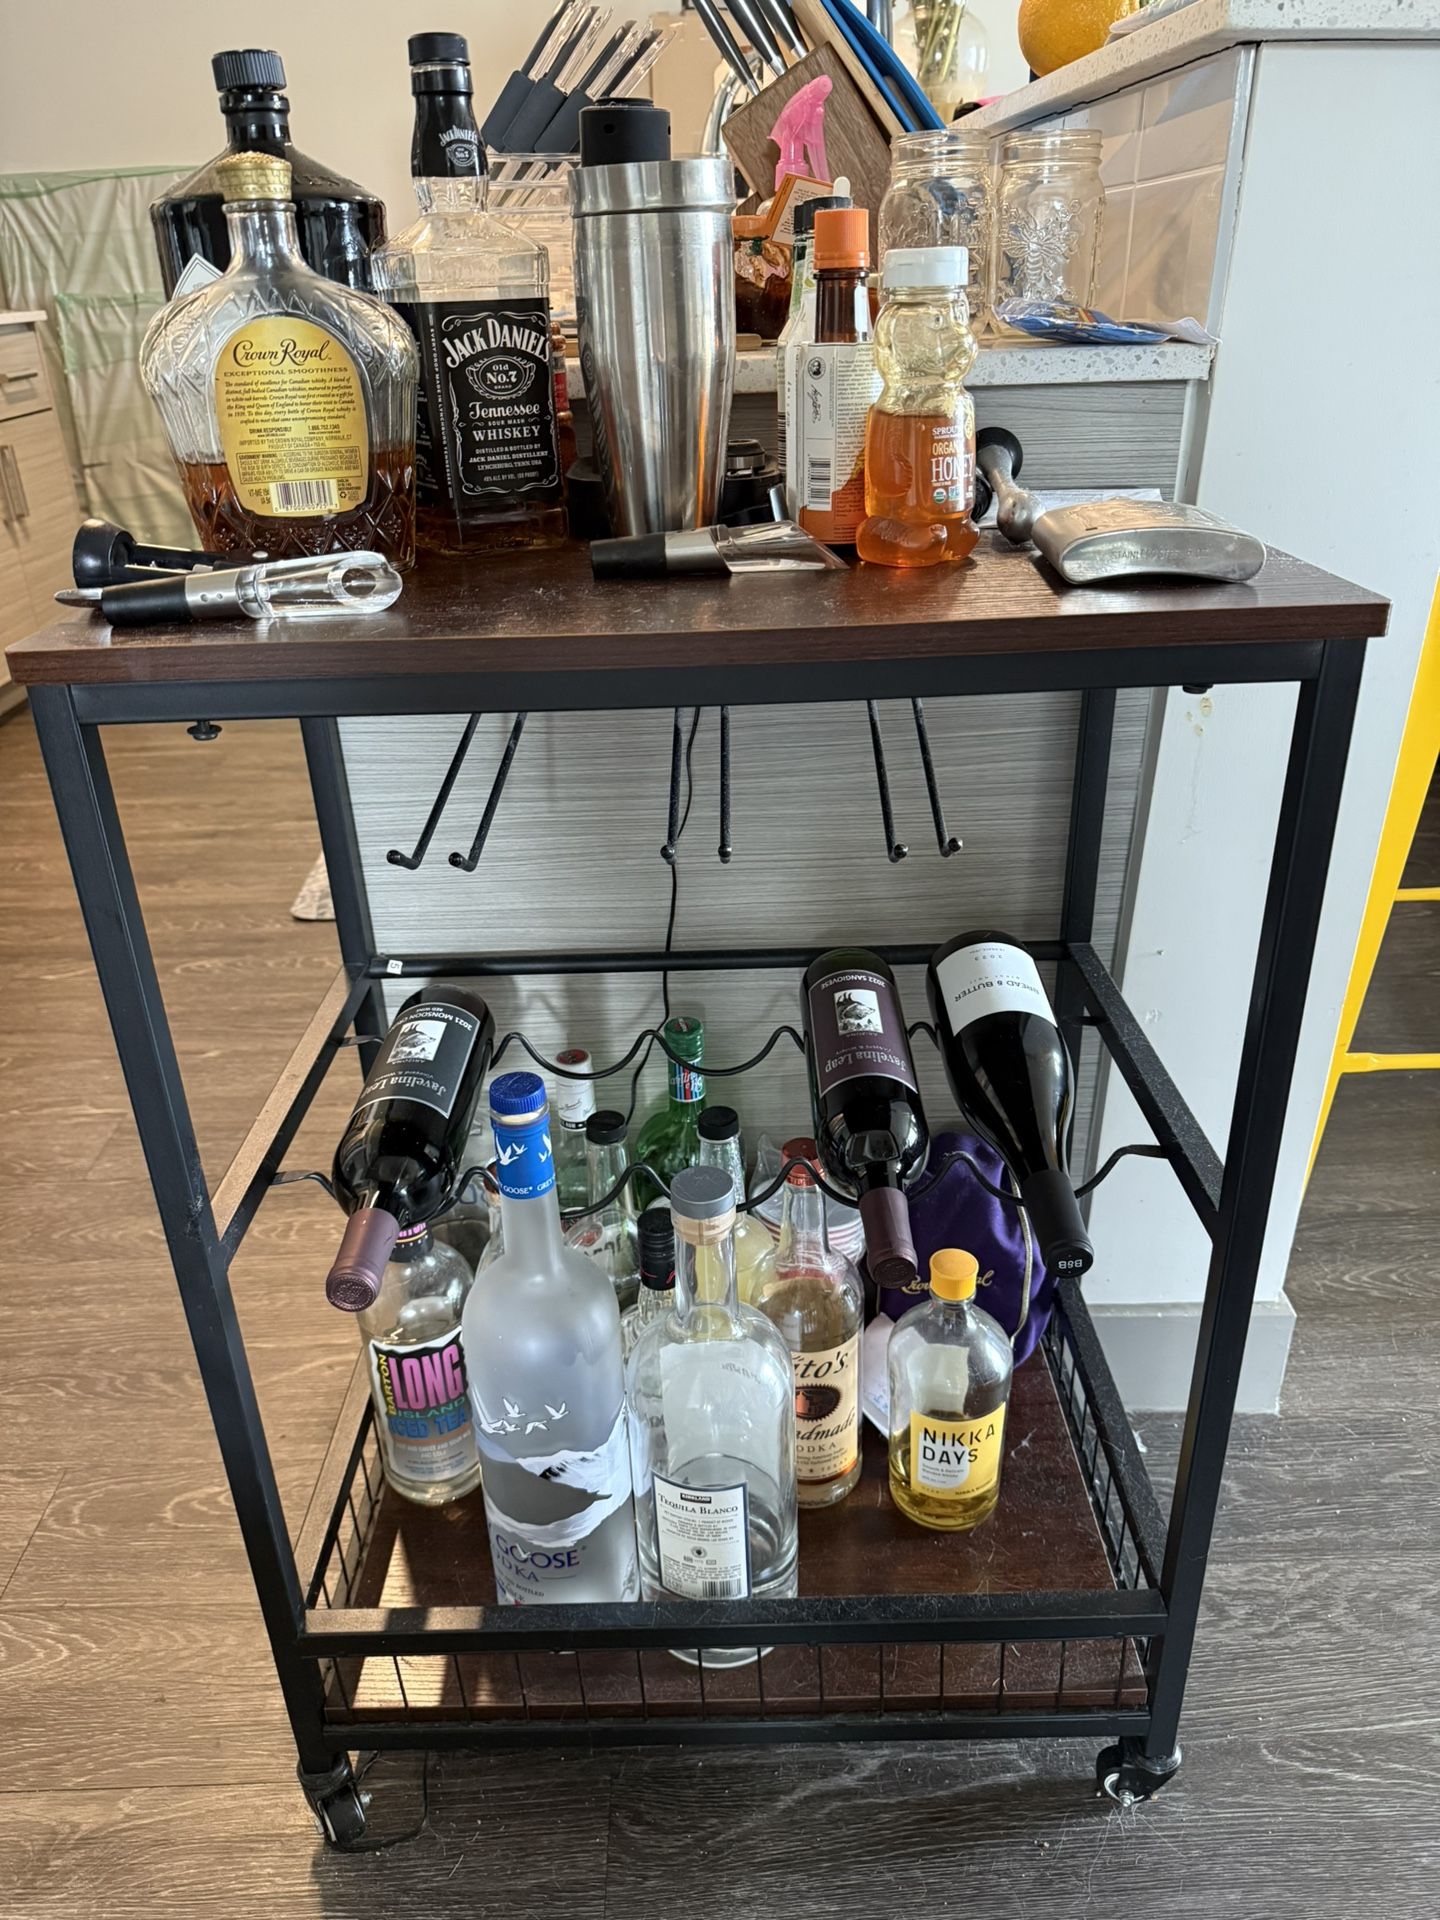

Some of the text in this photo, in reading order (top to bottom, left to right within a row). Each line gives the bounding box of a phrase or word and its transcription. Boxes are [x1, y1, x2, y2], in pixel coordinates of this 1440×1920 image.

[232, 338, 330, 367] Crown Royal
[442, 318, 550, 368] JACK DANIEL'S
[224, 369, 285, 377] EXCEPTIONAL
[486, 371, 517, 384] No.7
[469, 402, 540, 419] Tennessee
[472, 425, 540, 441] WHISKEY
[476, 446, 504, 454] DISTILLED
[487, 454, 511, 462] DANIEL
[512, 451, 548, 459] DISTILLERY
[821, 974, 886, 990] 2022 SANGIOVESE
[955, 981, 994, 1002] BUTTER
[408, 1012, 454, 1020] MONSOON
[454, 1016, 473, 1031] 2021
[825, 1050, 907, 1073] Javelina Leap
[362, 1075, 446, 1098] Javelina Lea
[503, 1186, 529, 1194] GOOSE
[793, 1351, 848, 1378] ito's
[379, 1353, 397, 1416] BARTON
[388, 1344, 464, 1409] LONG
[398, 1397, 465, 1418] ISLAND
[391, 1408, 466, 1438] ICED TEA
[924, 1424, 994, 1446] NIKKA
[796, 1442, 836, 1453] ODKA
[923, 1445, 978, 1465] DAYS
[658, 1493, 738, 1514] TEQUILA BLANCO
[496, 1534, 580, 1568] GOOSE
